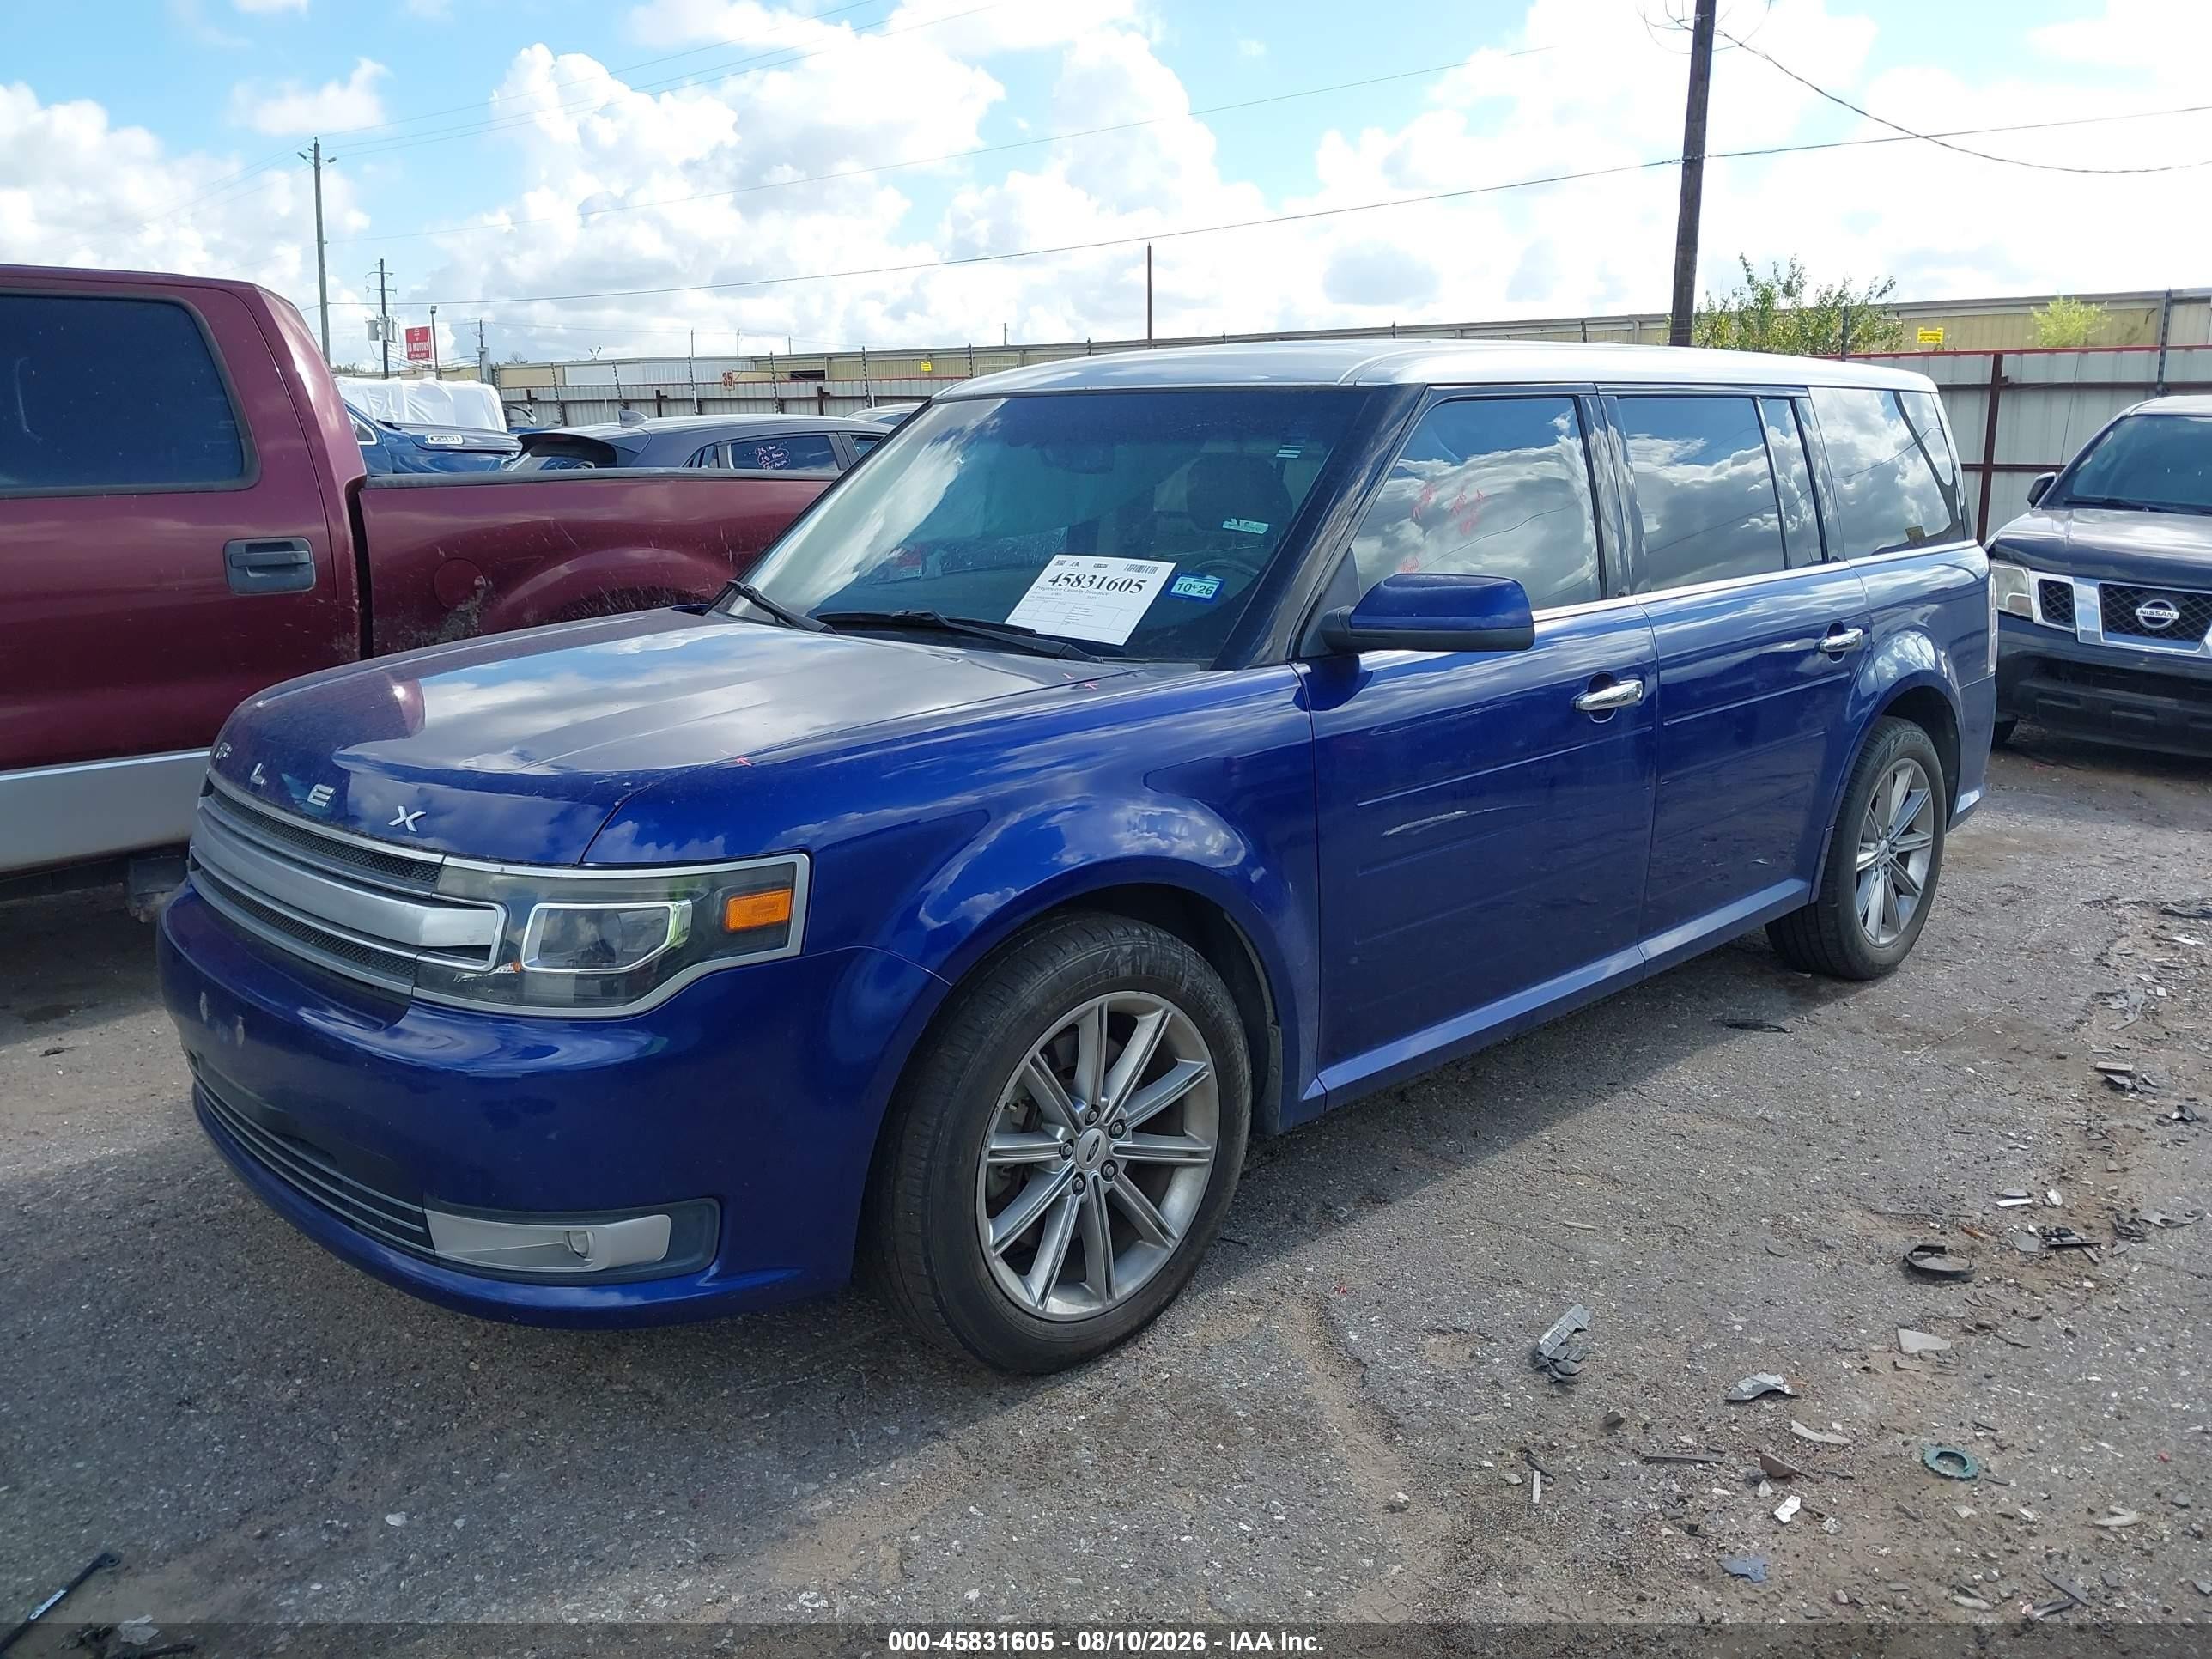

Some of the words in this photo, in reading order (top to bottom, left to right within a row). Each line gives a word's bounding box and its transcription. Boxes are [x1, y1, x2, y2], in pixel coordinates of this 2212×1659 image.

[722, 372, 732, 387] 35
[1048, 572, 1148, 594] 45831605
[1196, 585, 1215, 595] 26
